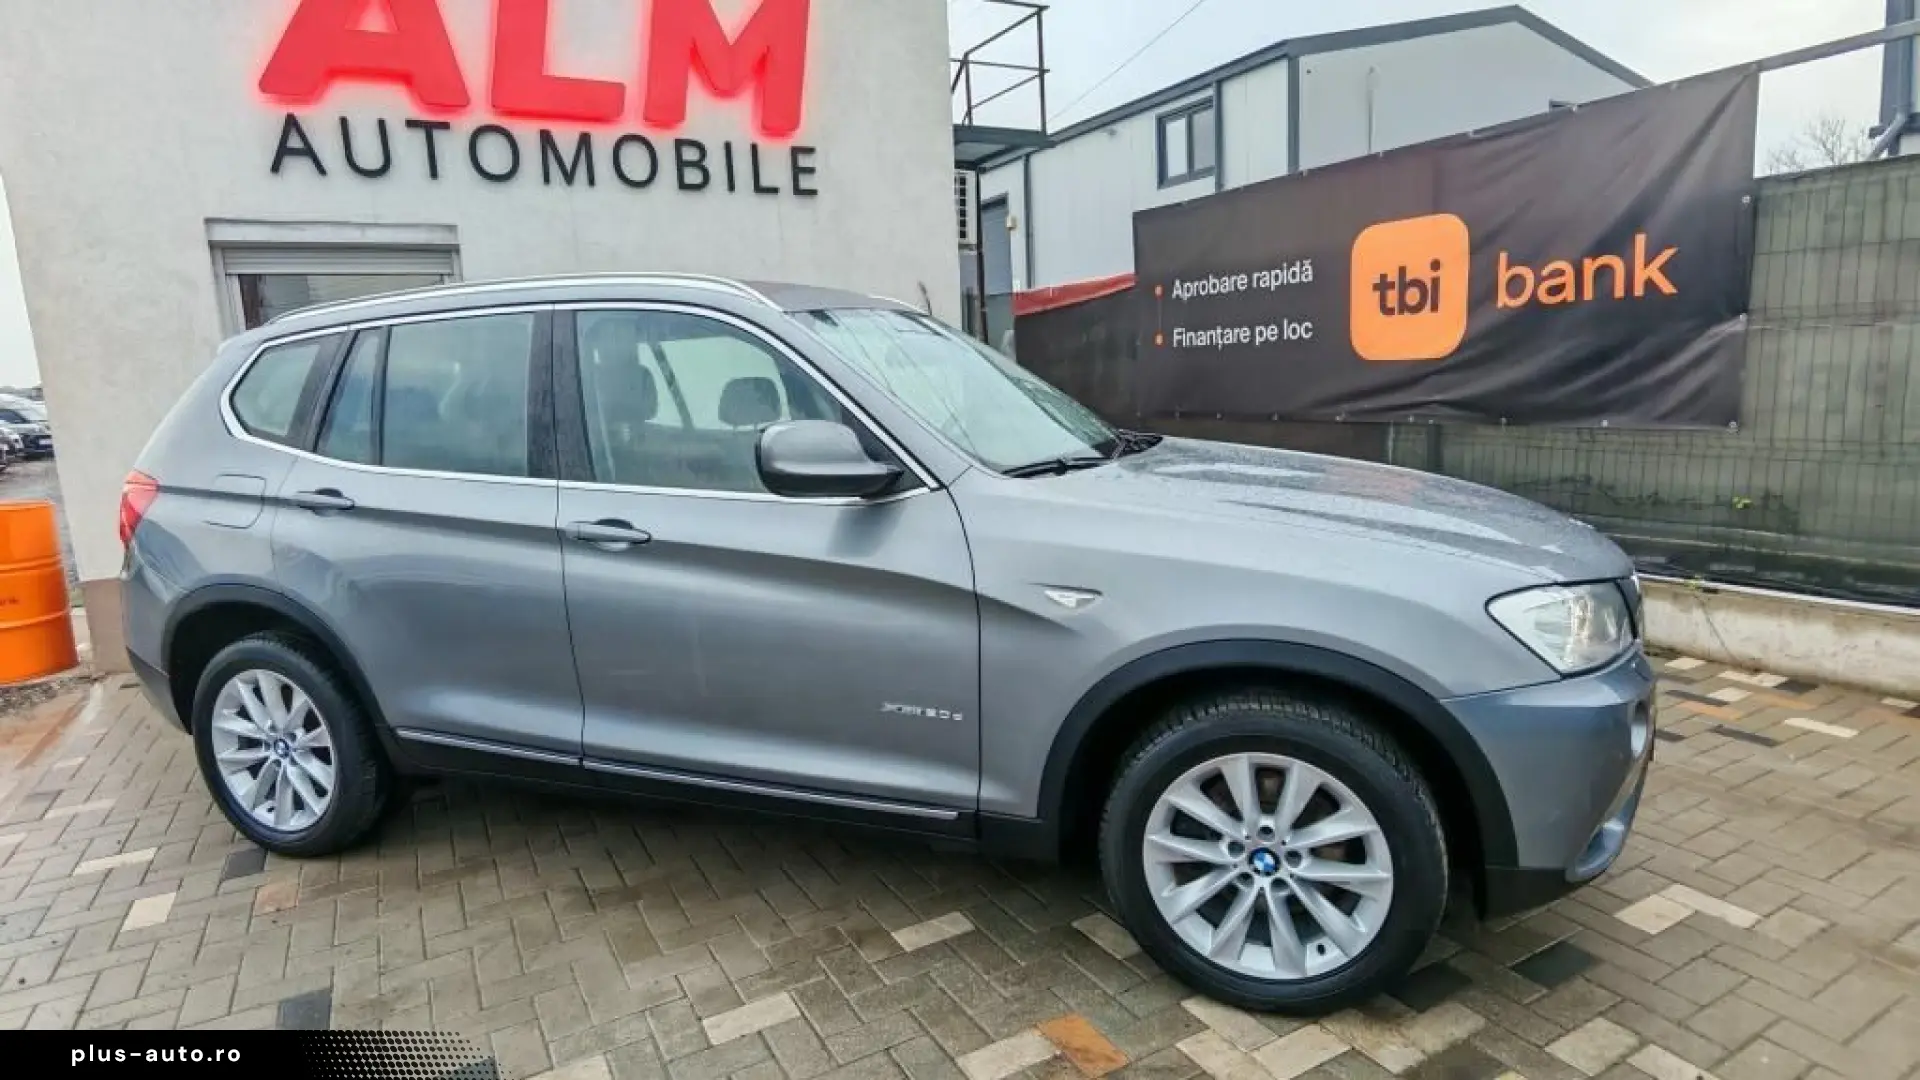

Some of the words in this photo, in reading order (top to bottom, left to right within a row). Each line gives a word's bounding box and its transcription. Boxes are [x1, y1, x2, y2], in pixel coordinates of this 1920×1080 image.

[258, 0, 811, 137] ALM
[270, 113, 818, 197] AUTOMOBILE
[1171, 274, 1249, 302] Aprobare
[1252, 258, 1314, 290] rapidă
[1372, 258, 1441, 316] tbi
[1496, 233, 1678, 308] bank
[1172, 326, 1250, 349] Finanțare
[1255, 323, 1278, 345] pe
[1283, 318, 1313, 340] loc
